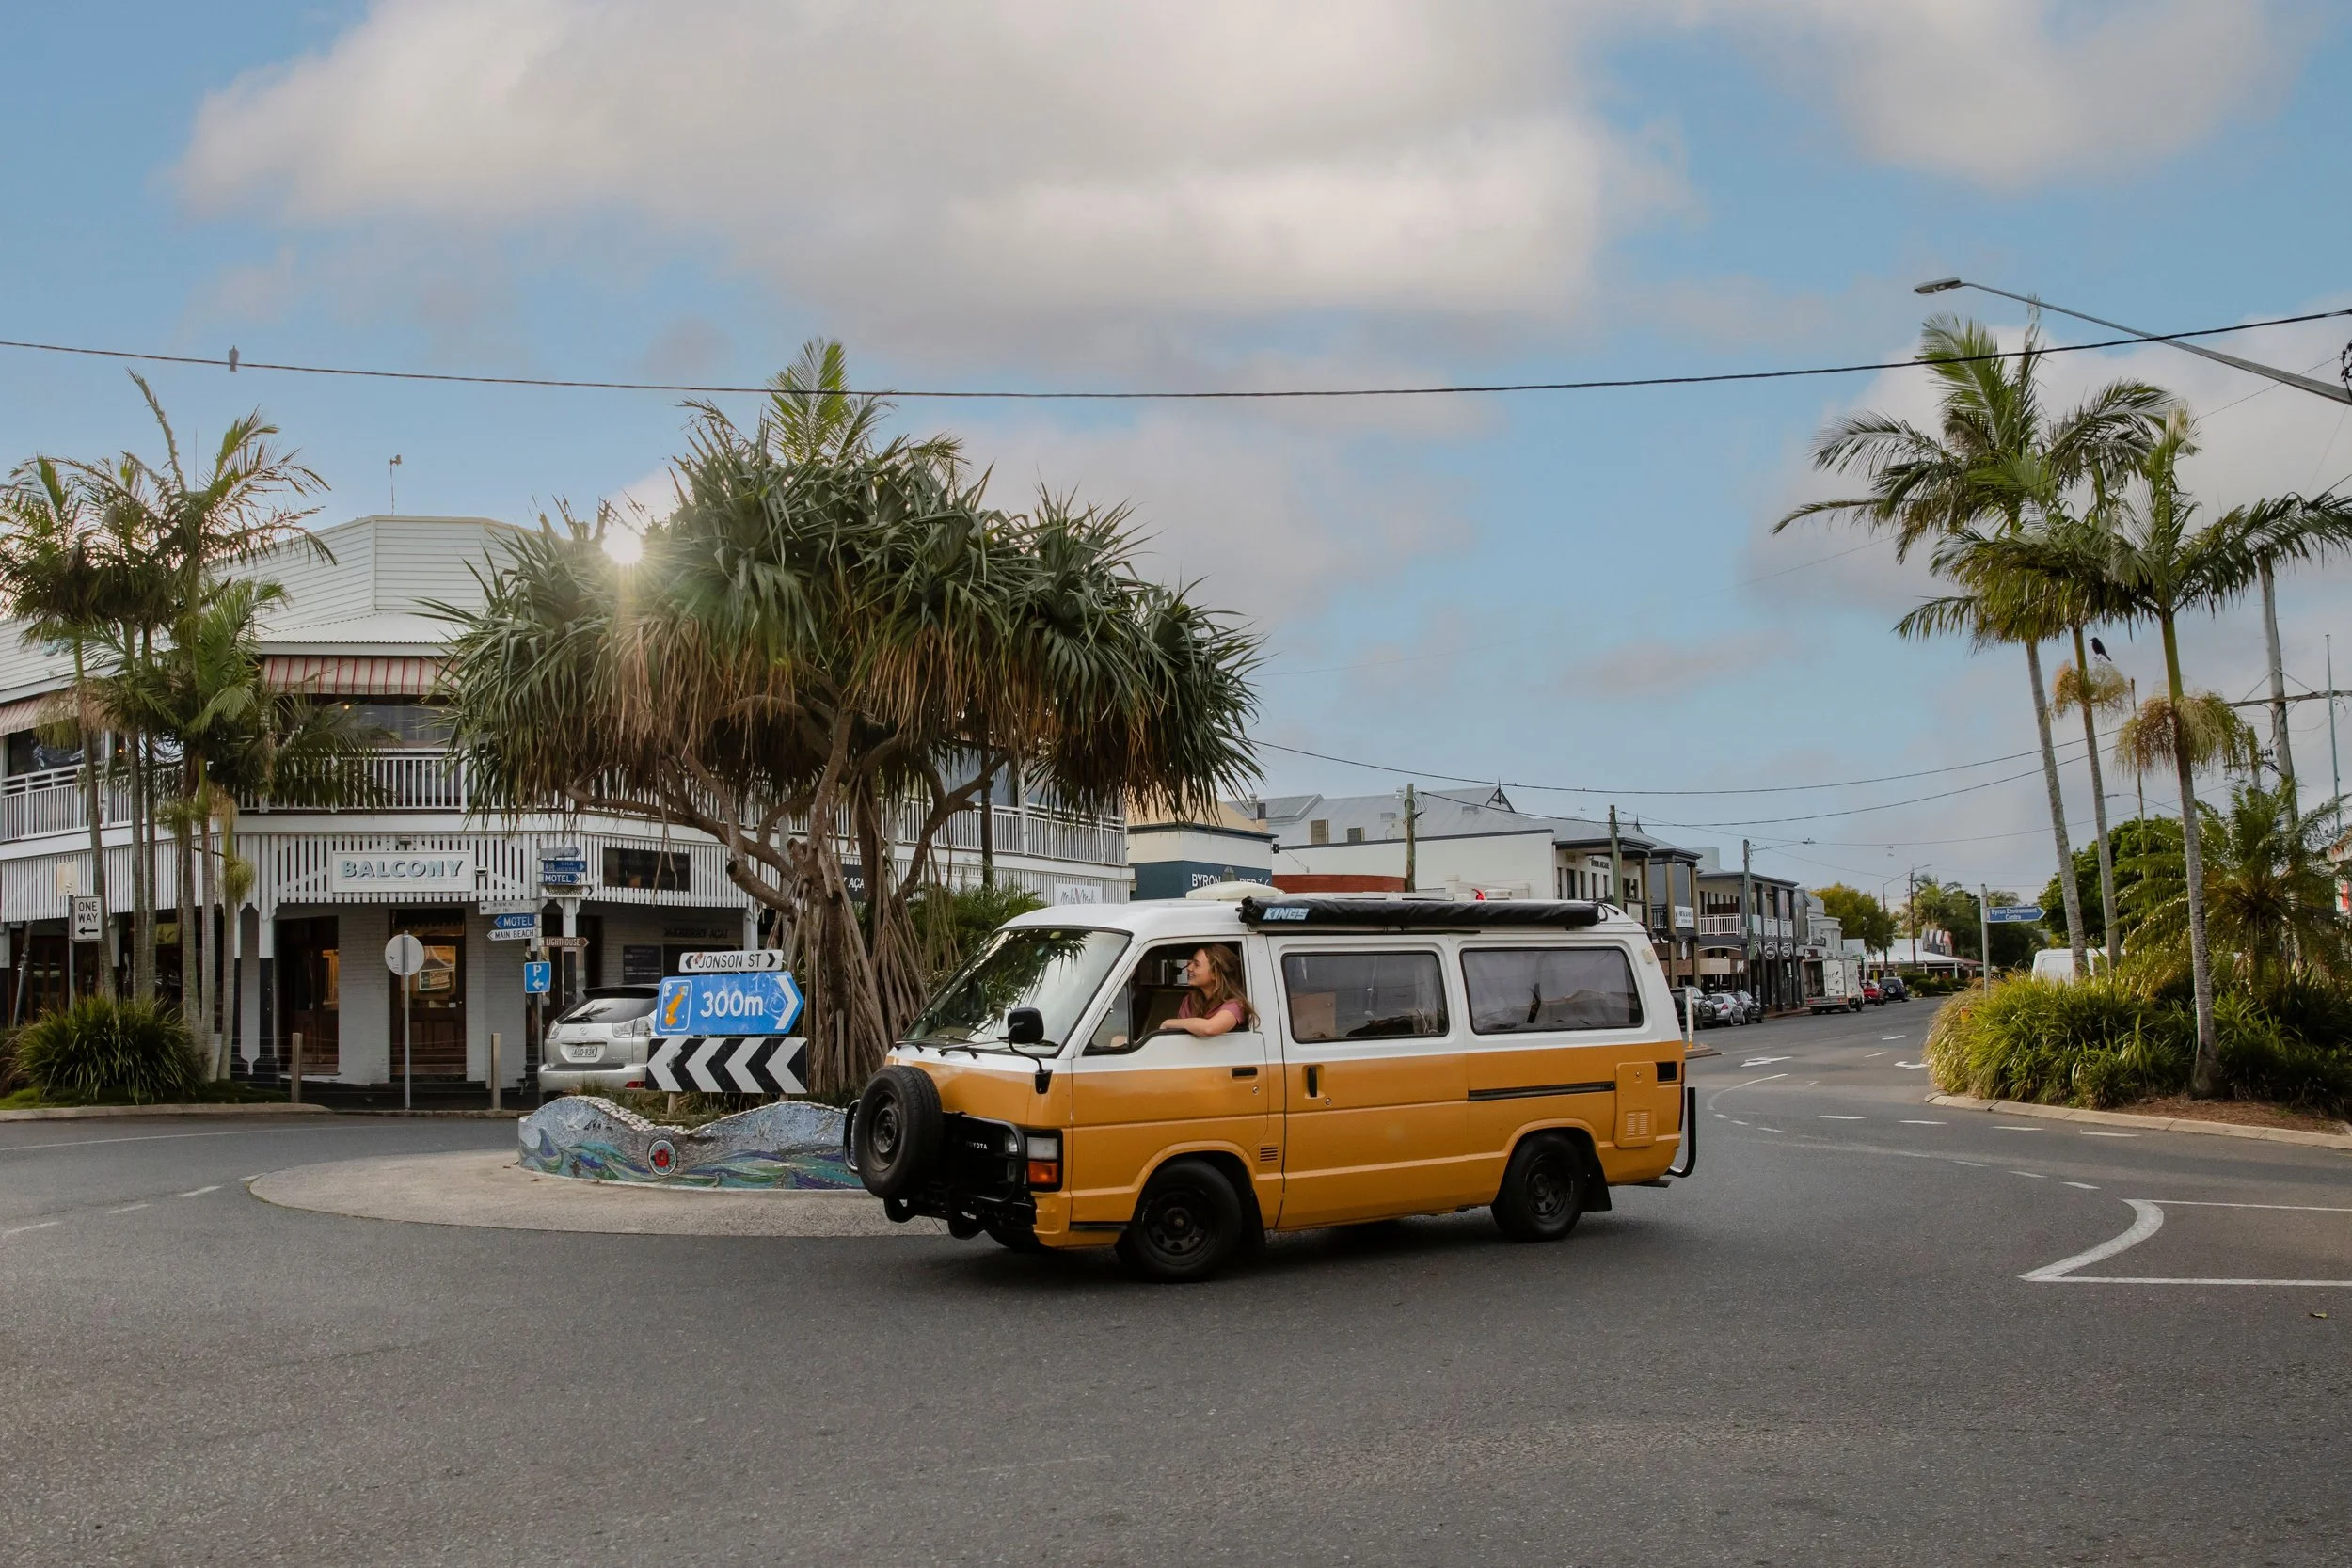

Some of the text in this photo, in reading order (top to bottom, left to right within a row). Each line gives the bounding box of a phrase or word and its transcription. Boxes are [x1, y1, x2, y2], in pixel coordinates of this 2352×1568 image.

[341, 860, 464, 879] BALCONY
[545, 874, 572, 882] MOTEL
[1191, 873, 1221, 887] BYRON
[848, 877, 865, 892] AÇA
[78, 901, 98, 911] ONE
[78, 913, 98, 923] WAY
[1263, 907, 1309, 920] KINGS
[503, 916, 533, 927] MOTEL
[494, 929, 534, 939] MAIN BEACH
[699, 953, 761, 969] JONSON ST
[532, 965, 542, 976] P
[700, 990, 764, 1018] 300m
